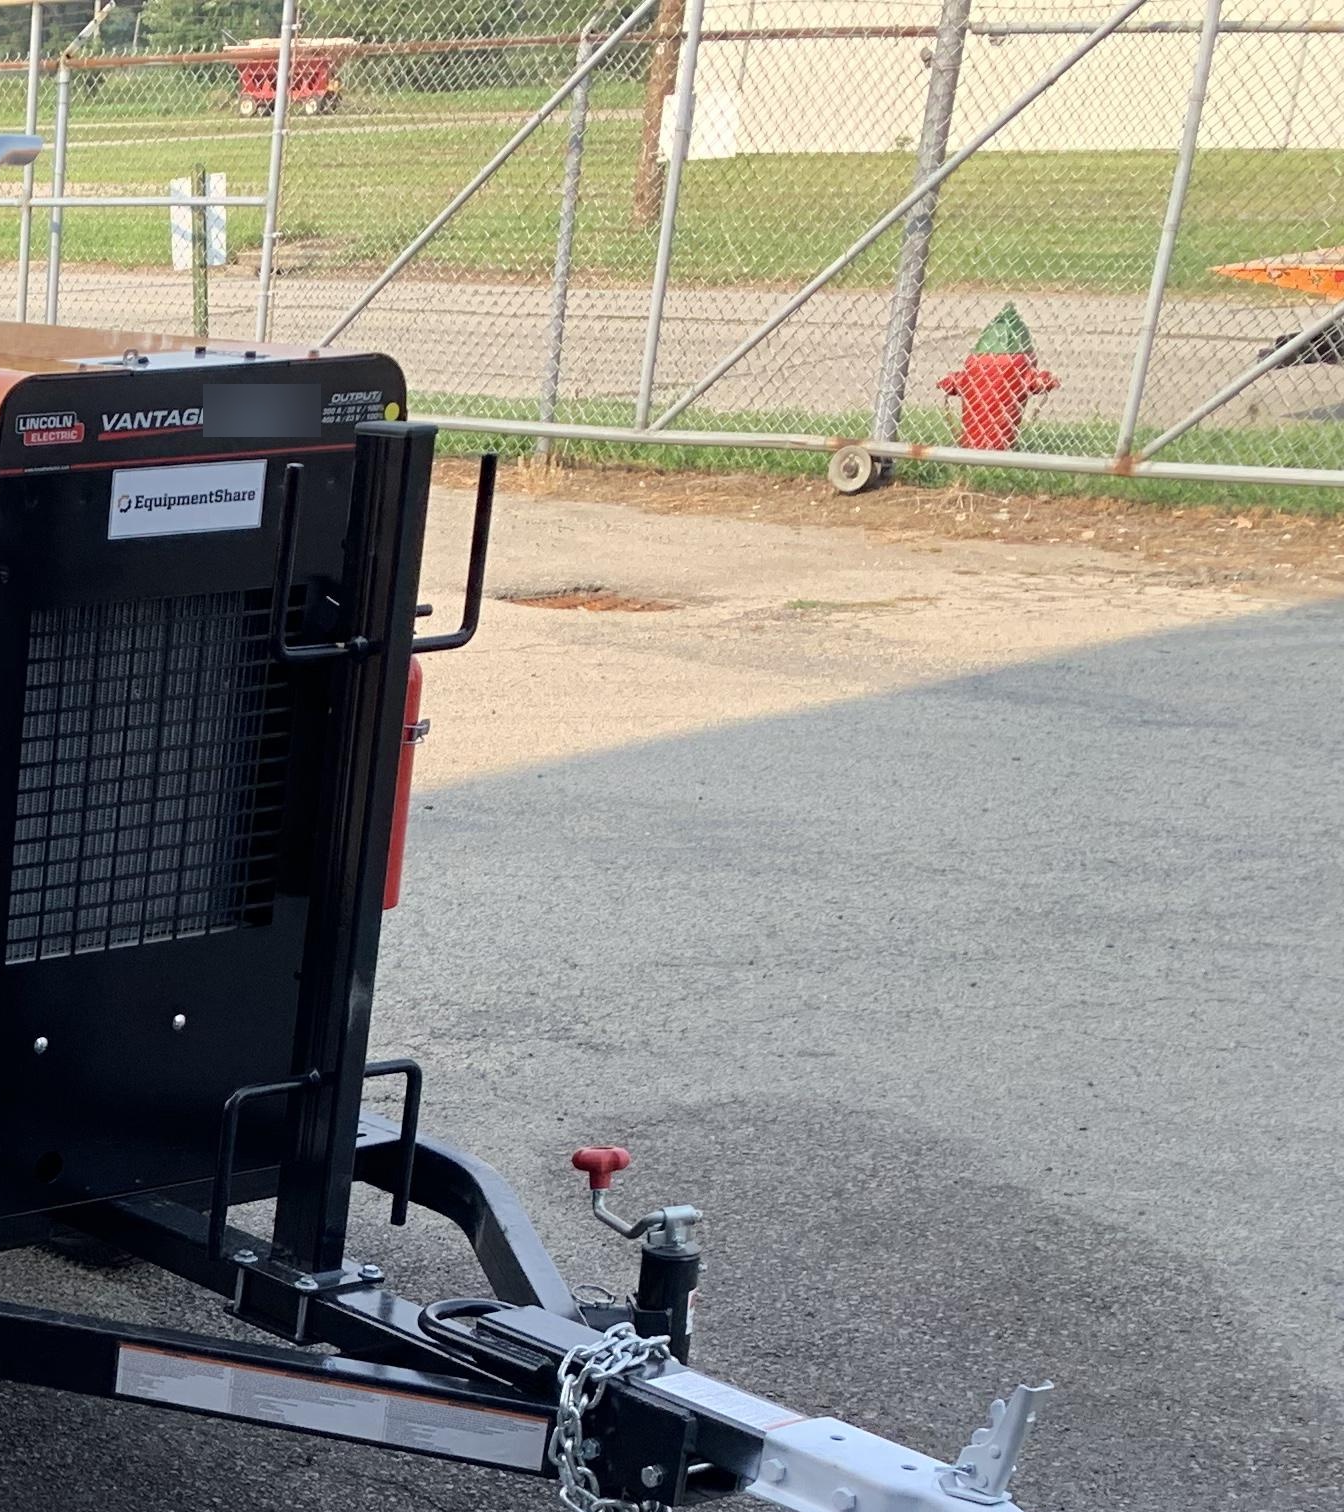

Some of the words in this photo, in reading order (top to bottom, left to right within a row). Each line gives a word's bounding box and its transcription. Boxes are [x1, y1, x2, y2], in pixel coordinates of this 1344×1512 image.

[331, 391, 379, 403] OUTPUT
[18, 414, 74, 431] LINCOLN
[101, 408, 204, 431] VANTAG
[30, 430, 78, 442] ELECTRIC
[134, 488, 256, 511] EquipmentShare
